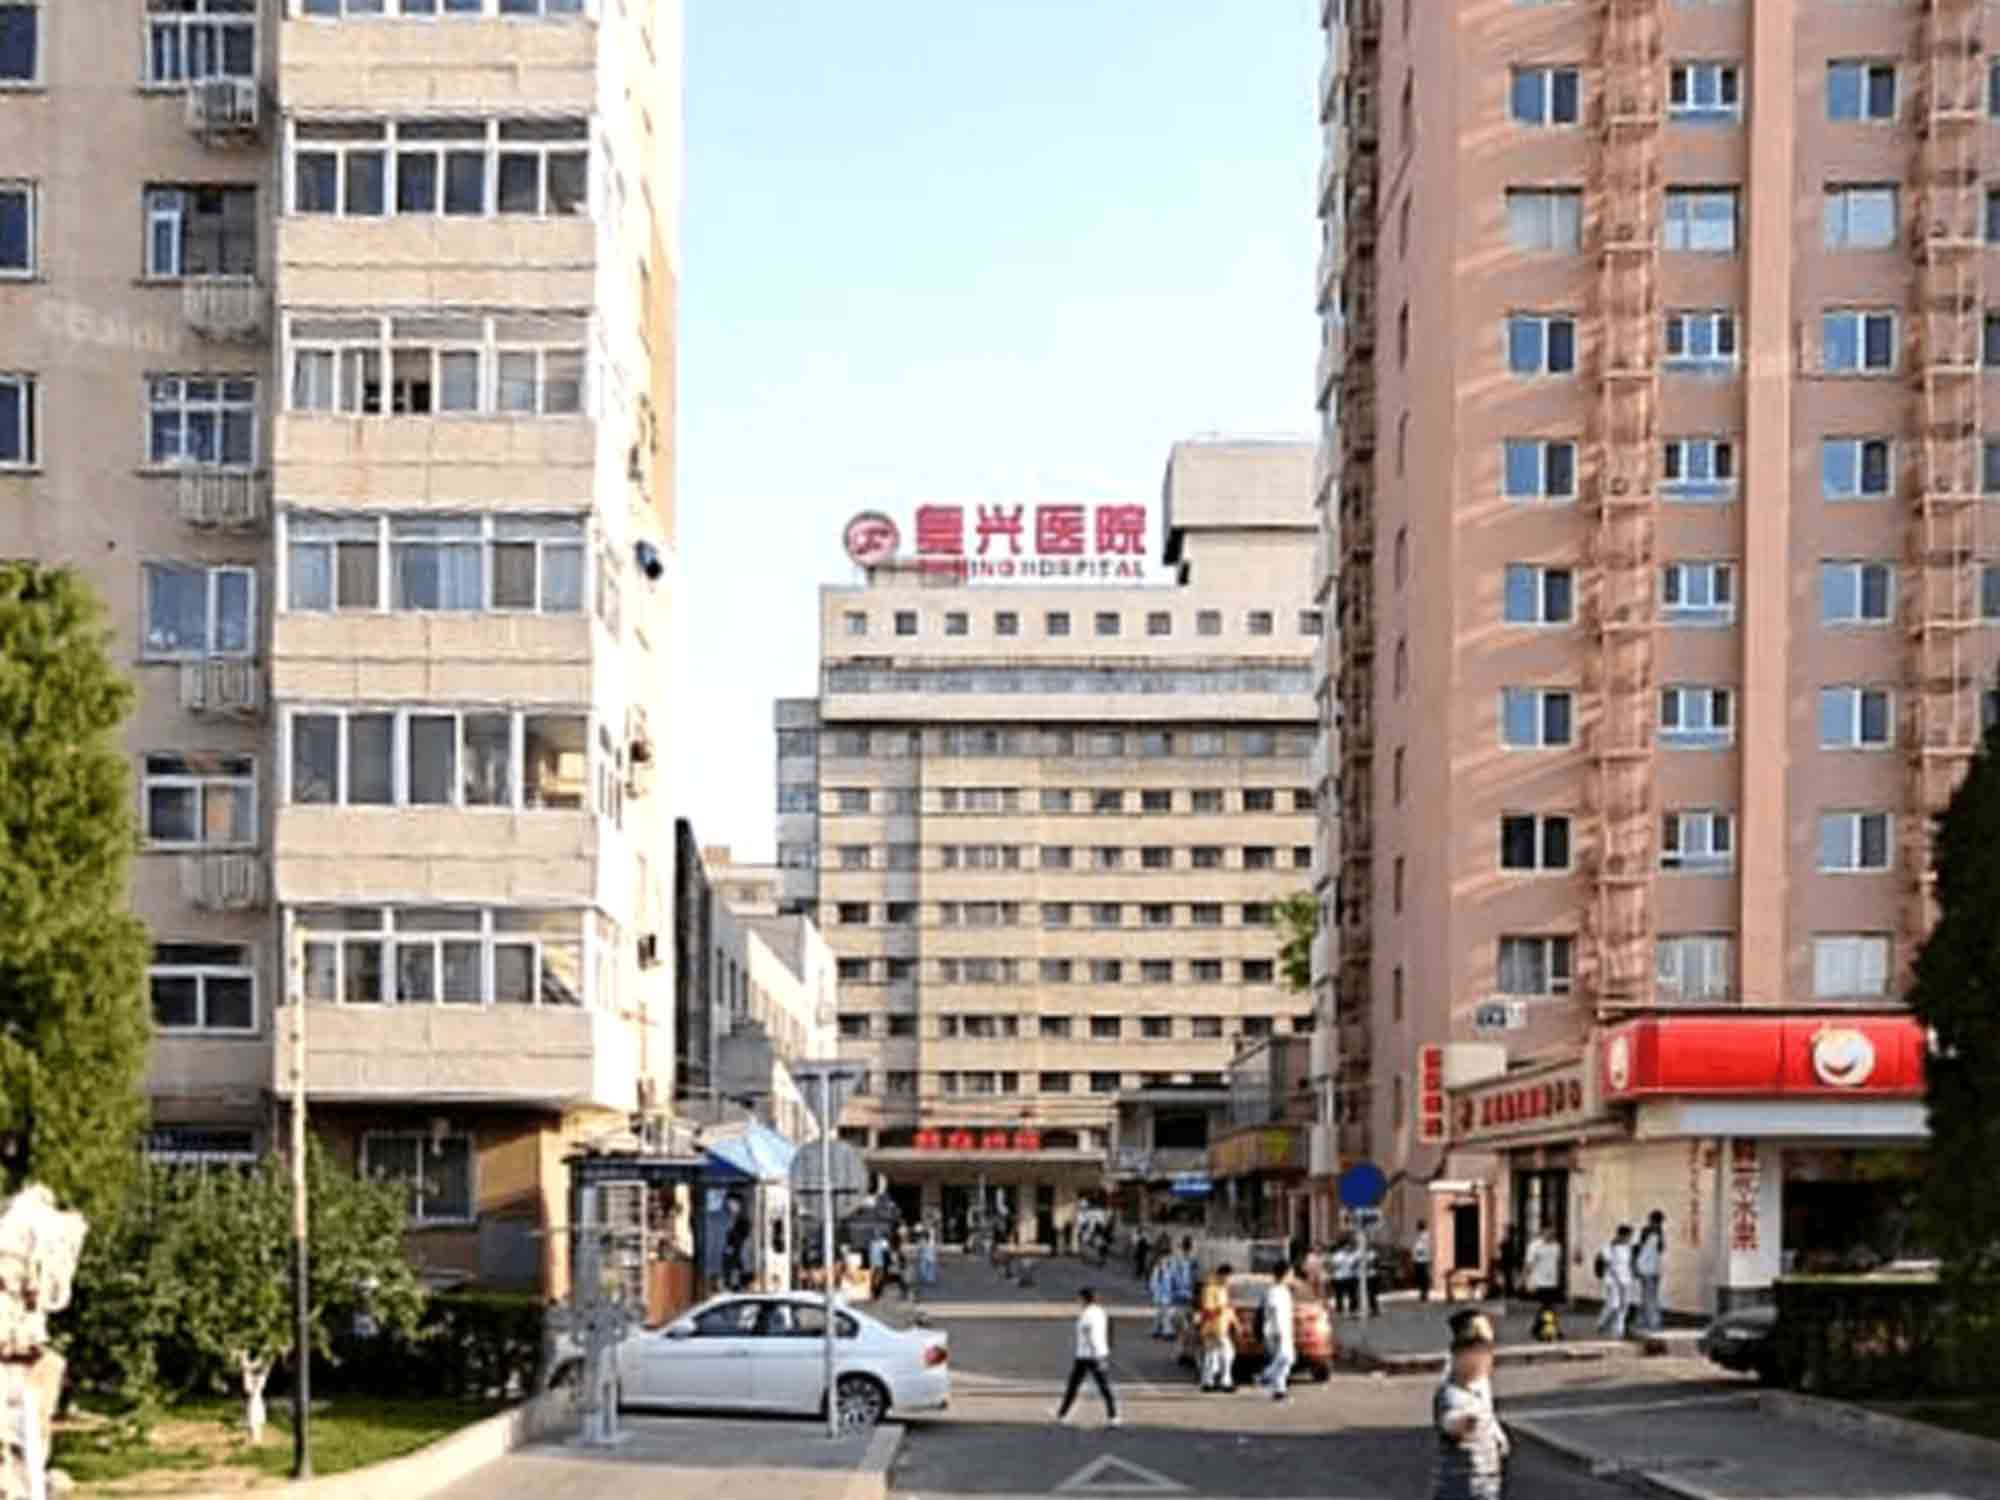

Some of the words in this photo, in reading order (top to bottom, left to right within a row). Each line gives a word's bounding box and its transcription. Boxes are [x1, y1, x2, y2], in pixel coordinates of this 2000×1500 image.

[915, 504, 1146, 555] 复兴医院
[1020, 559, 1146, 576] HOSPITAL
